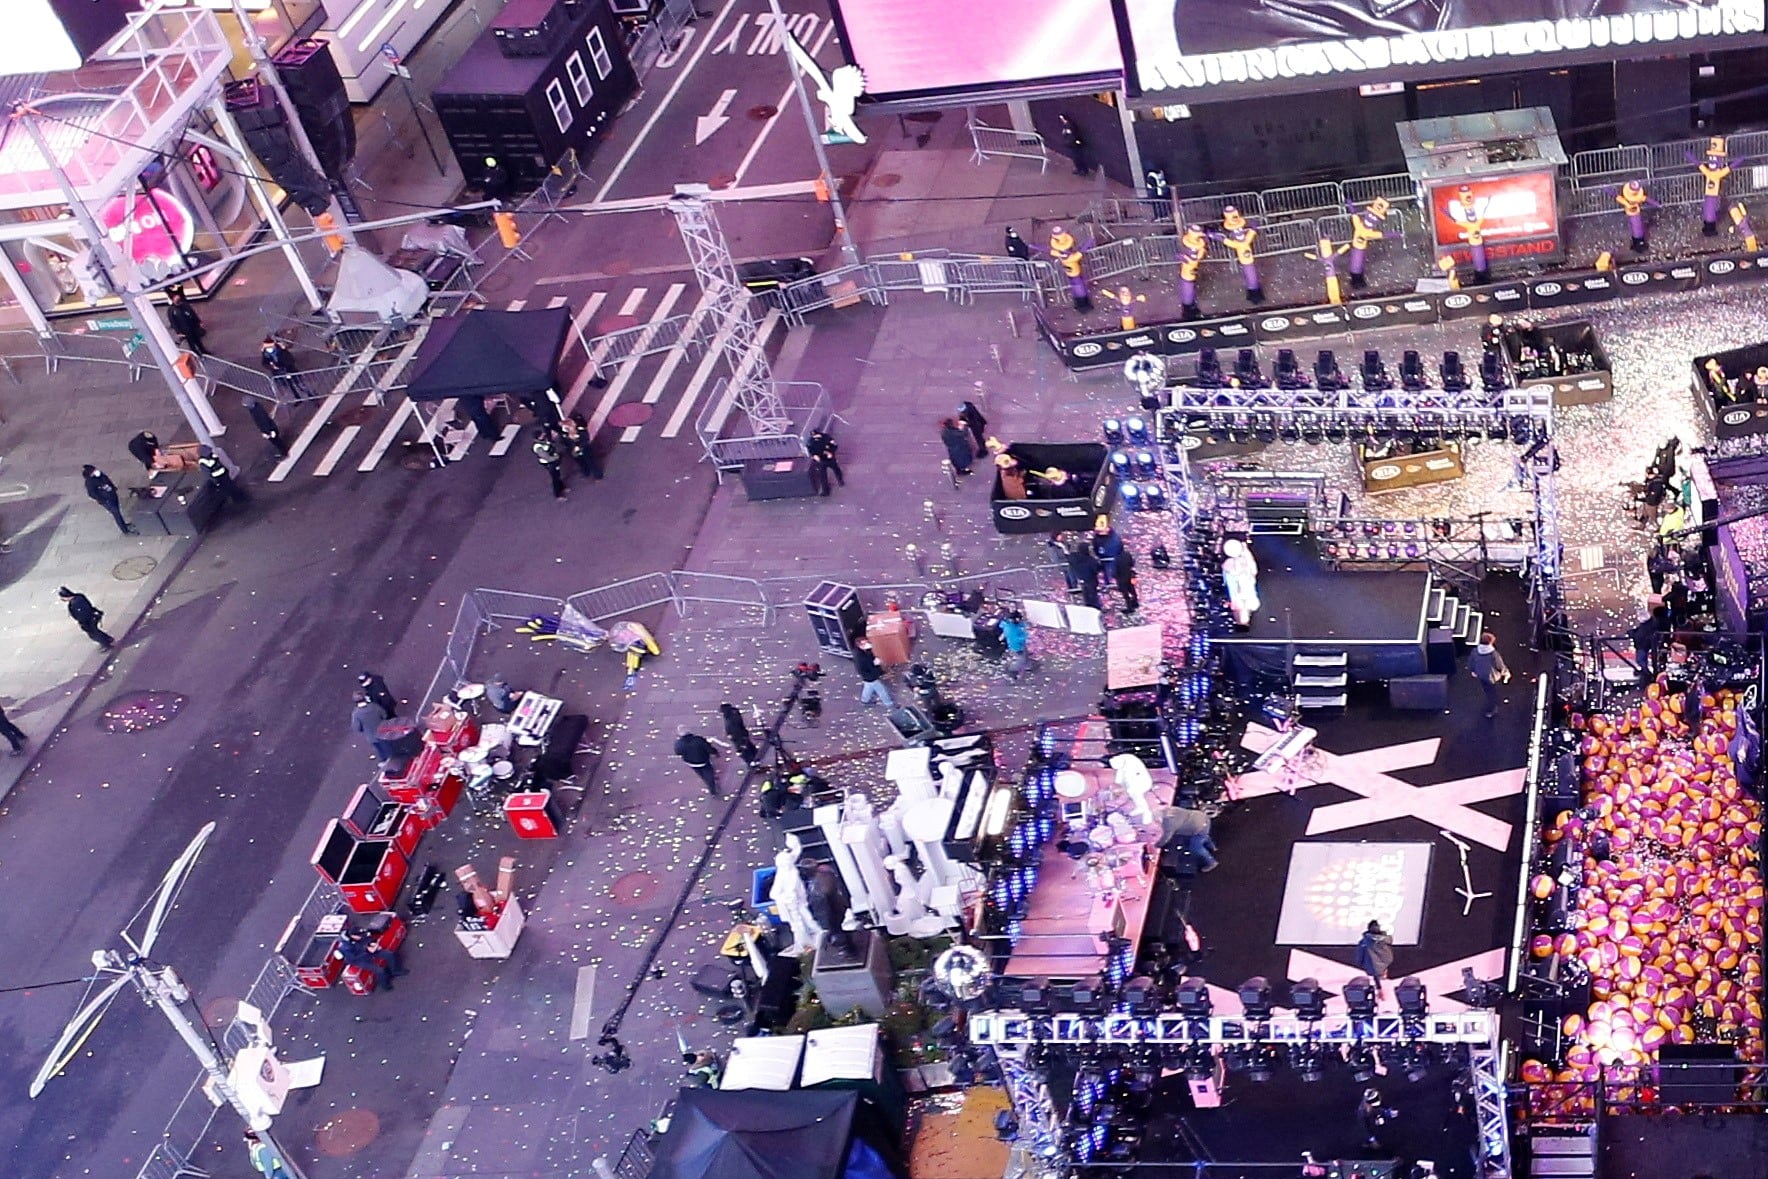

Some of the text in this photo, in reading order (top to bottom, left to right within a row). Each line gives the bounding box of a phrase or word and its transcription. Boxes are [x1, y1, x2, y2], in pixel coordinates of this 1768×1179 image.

[1711, 261, 1733, 273] KIA
[1624, 273, 1647, 284] KIA
[1537, 283, 1559, 294] KIA
[1446, 296, 1470, 307] KIA
[1356, 306, 1379, 317] KIA
[1263, 318, 1288, 330] KIA
[1170, 330, 1194, 342] KIA
[1075, 344, 1100, 356] KIA
[1725, 412, 1749, 423] KIA
[1002, 507, 1028, 518] KIA
